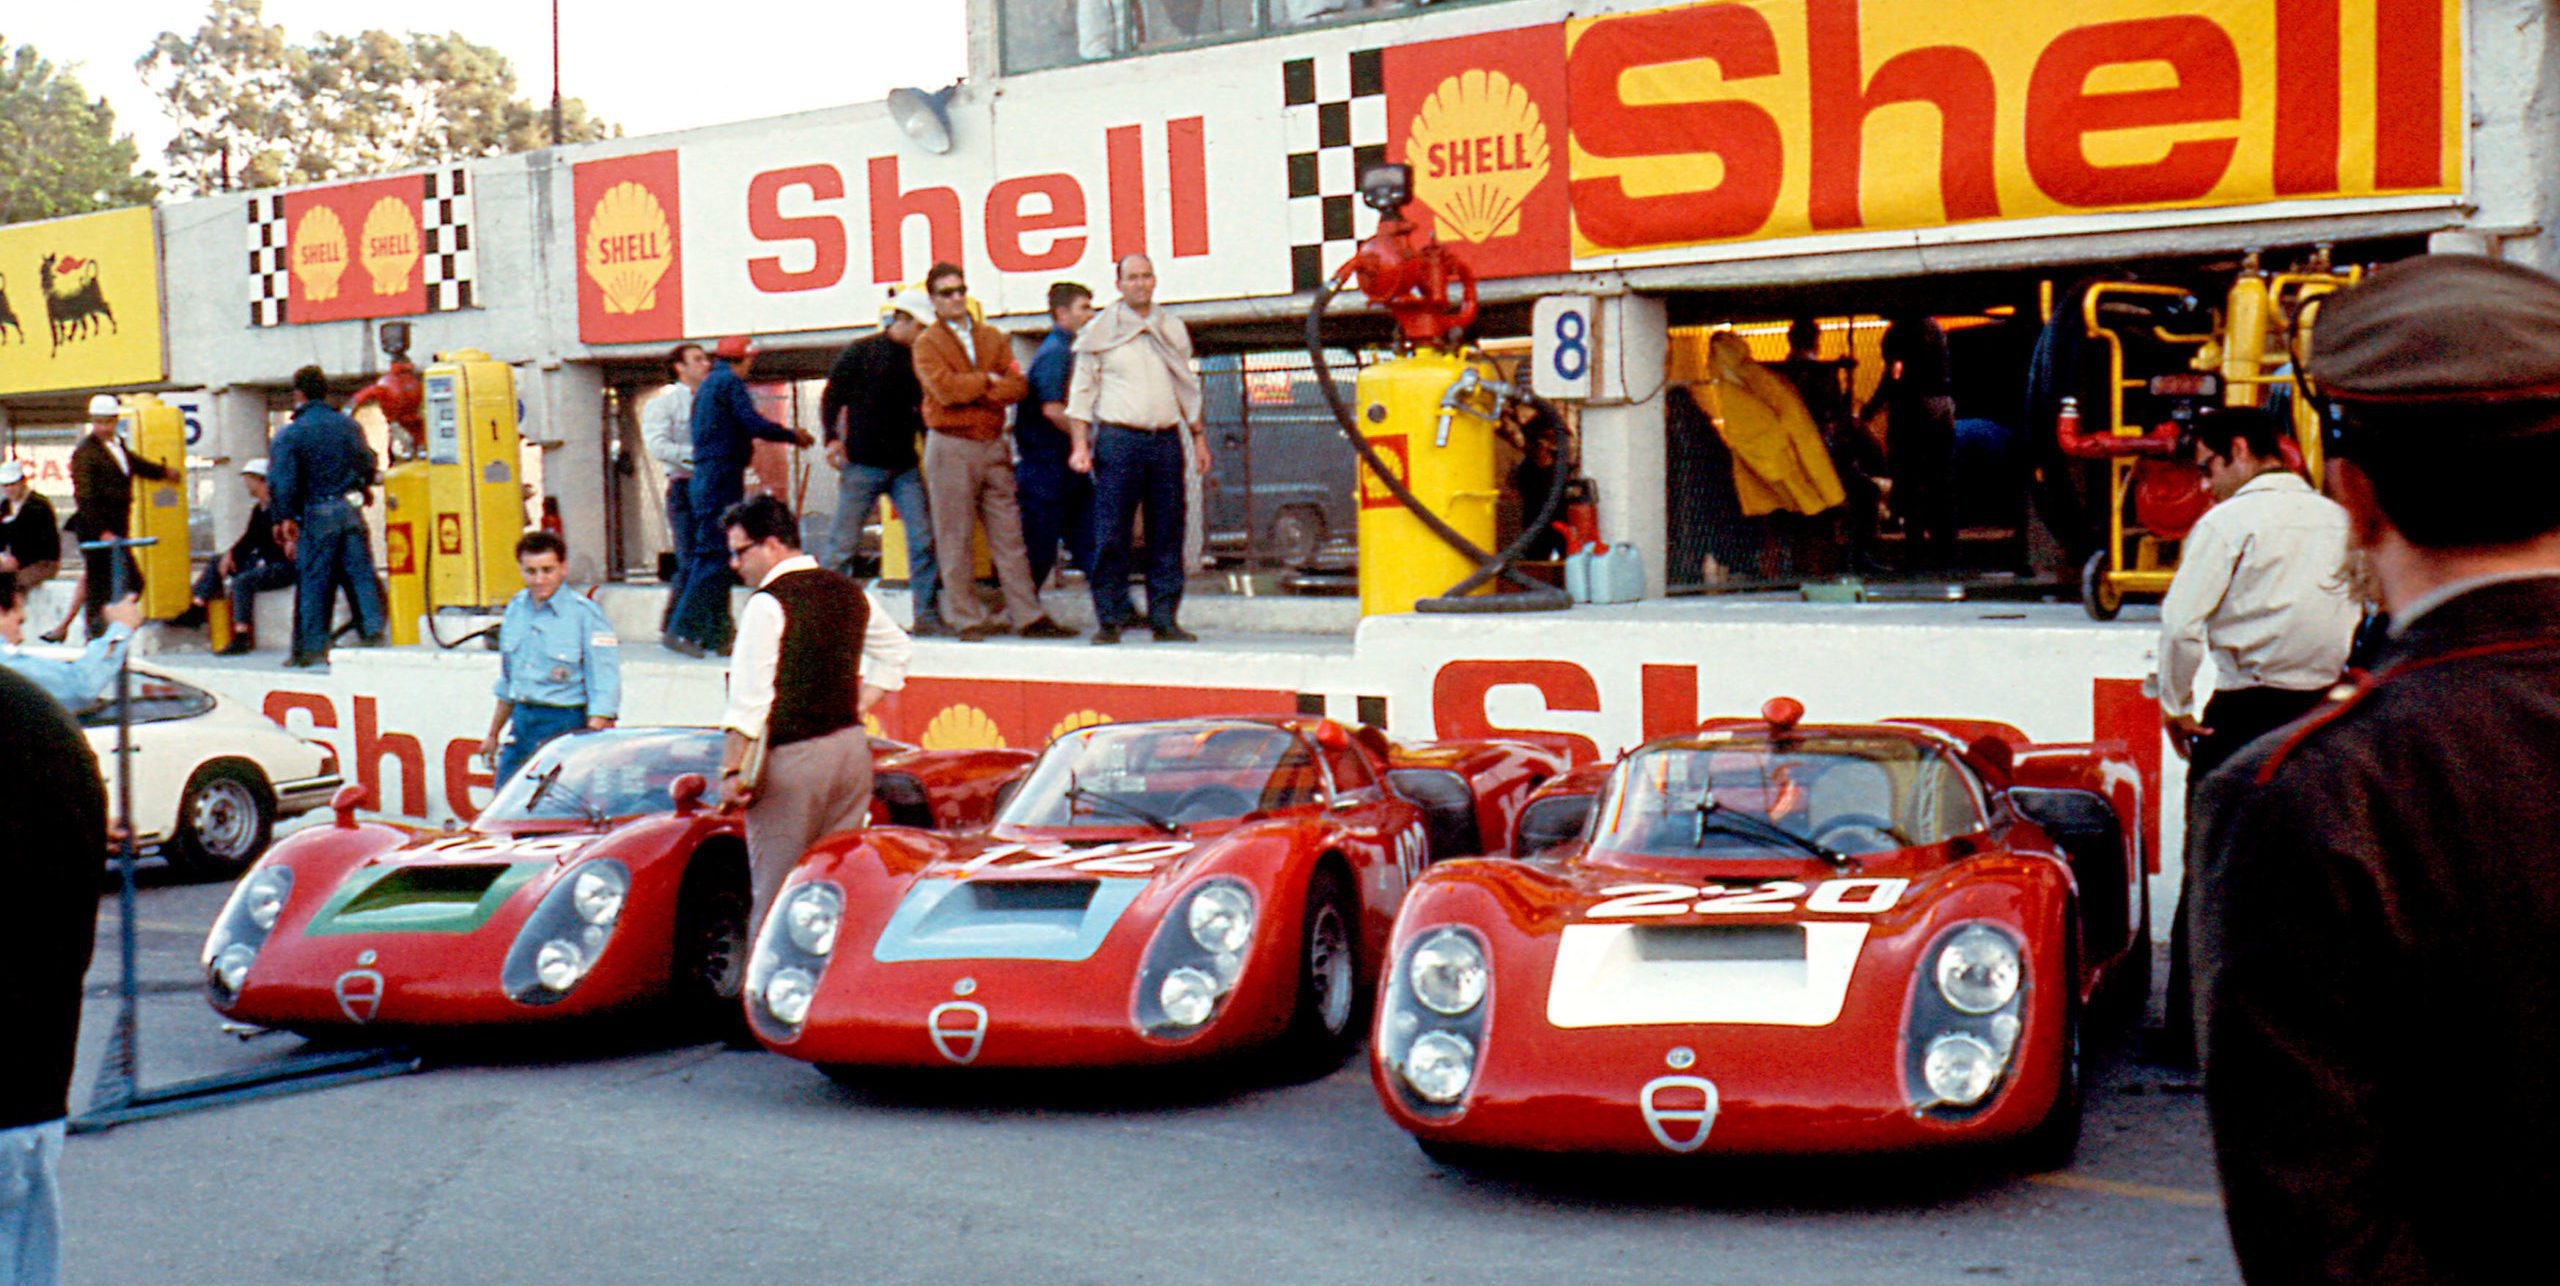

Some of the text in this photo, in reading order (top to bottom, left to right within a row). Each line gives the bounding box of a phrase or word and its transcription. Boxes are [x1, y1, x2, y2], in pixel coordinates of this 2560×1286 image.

[1568, 0, 2443, 249] Shell
[1427, 132, 1532, 179] SHELL
[747, 115, 1209, 294] Shell
[302, 240, 340, 265] SHELL
[370, 232, 411, 258] SHELL
[599, 231, 661, 265] SHELL
[1554, 310, 1586, 380] 8
[179, 404, 201, 446] 5
[1586, 877, 1910, 918] 220
